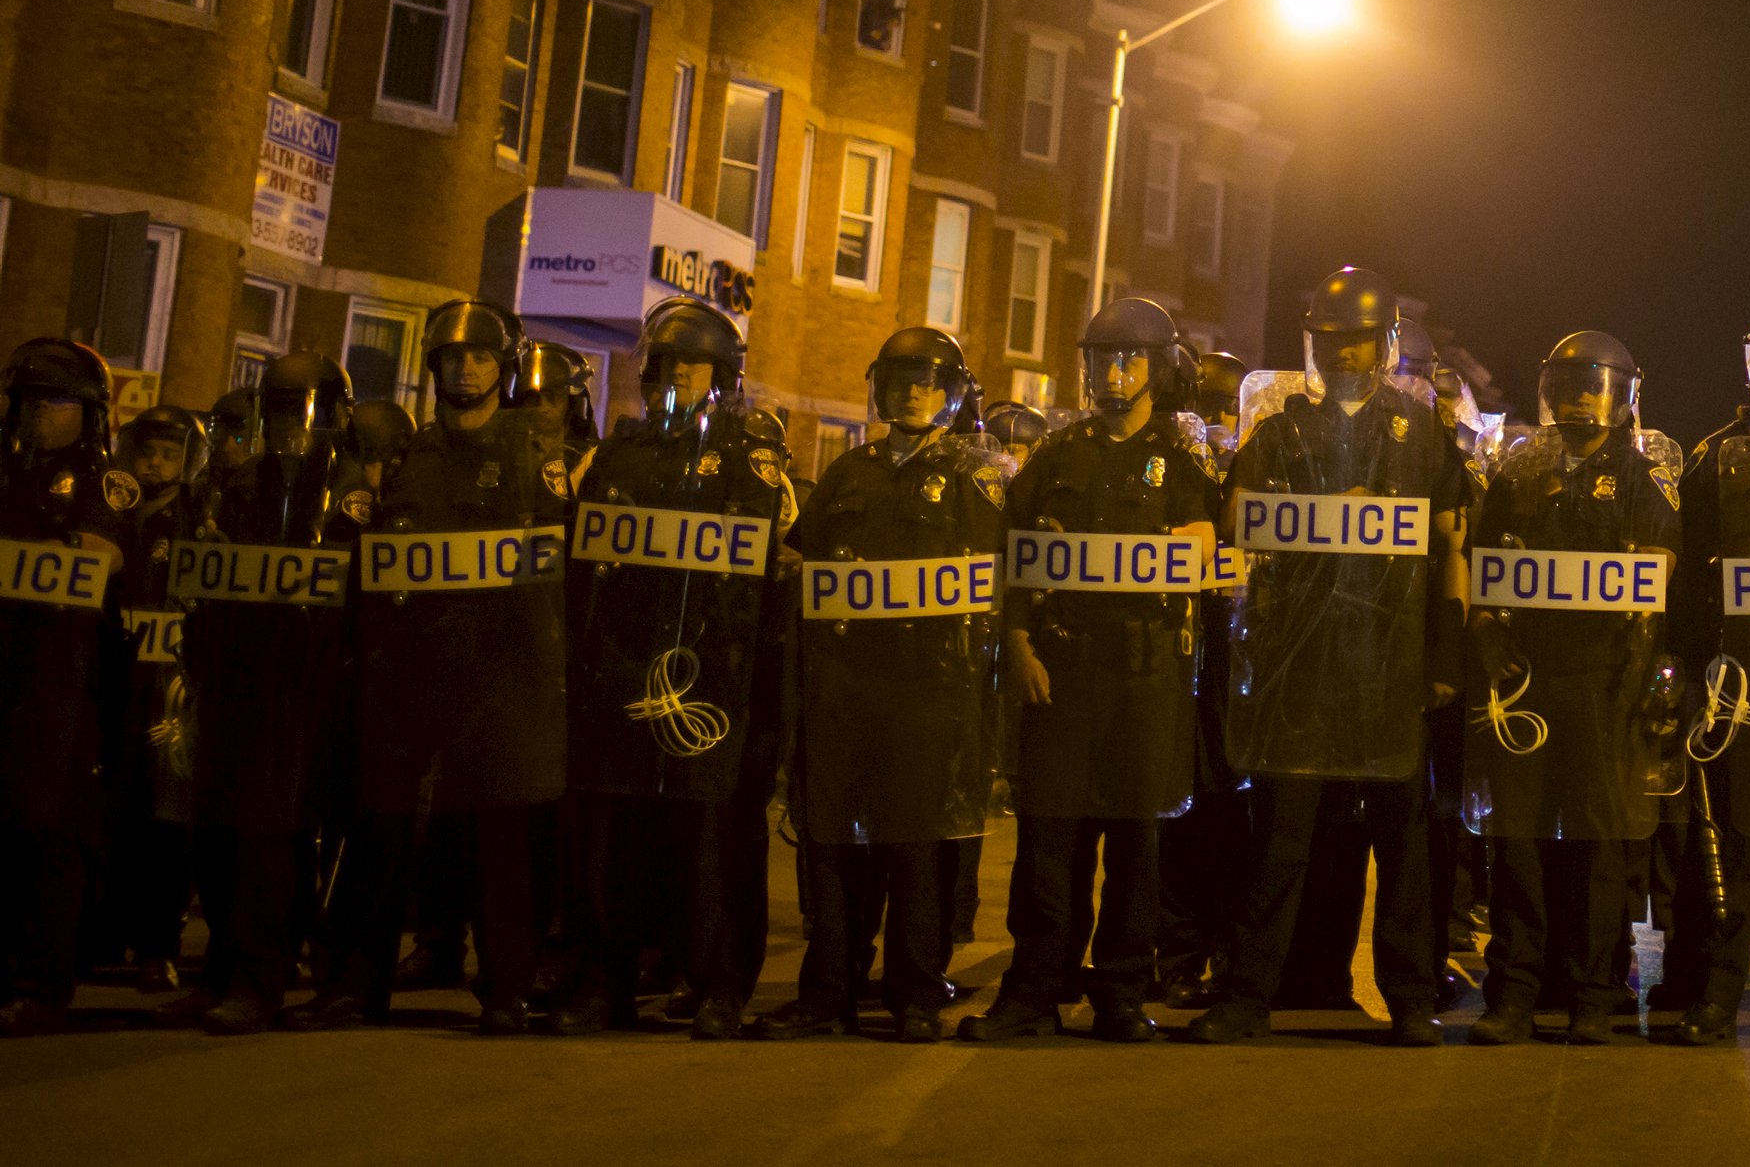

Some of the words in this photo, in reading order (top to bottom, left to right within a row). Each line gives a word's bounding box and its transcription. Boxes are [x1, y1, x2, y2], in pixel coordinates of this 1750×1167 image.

[271, 104, 334, 155] BRYSON
[298, 156, 332, 186] CARE
[581, 510, 759, 566] POLICE
[1243, 500, 1419, 547] POLICE
[176, 548, 338, 597] POLICE
[371, 534, 556, 583] POLICE
[1015, 538, 1192, 584] POLICE
[1480, 555, 1658, 603] POLICE
[812, 562, 993, 610] POLICE
